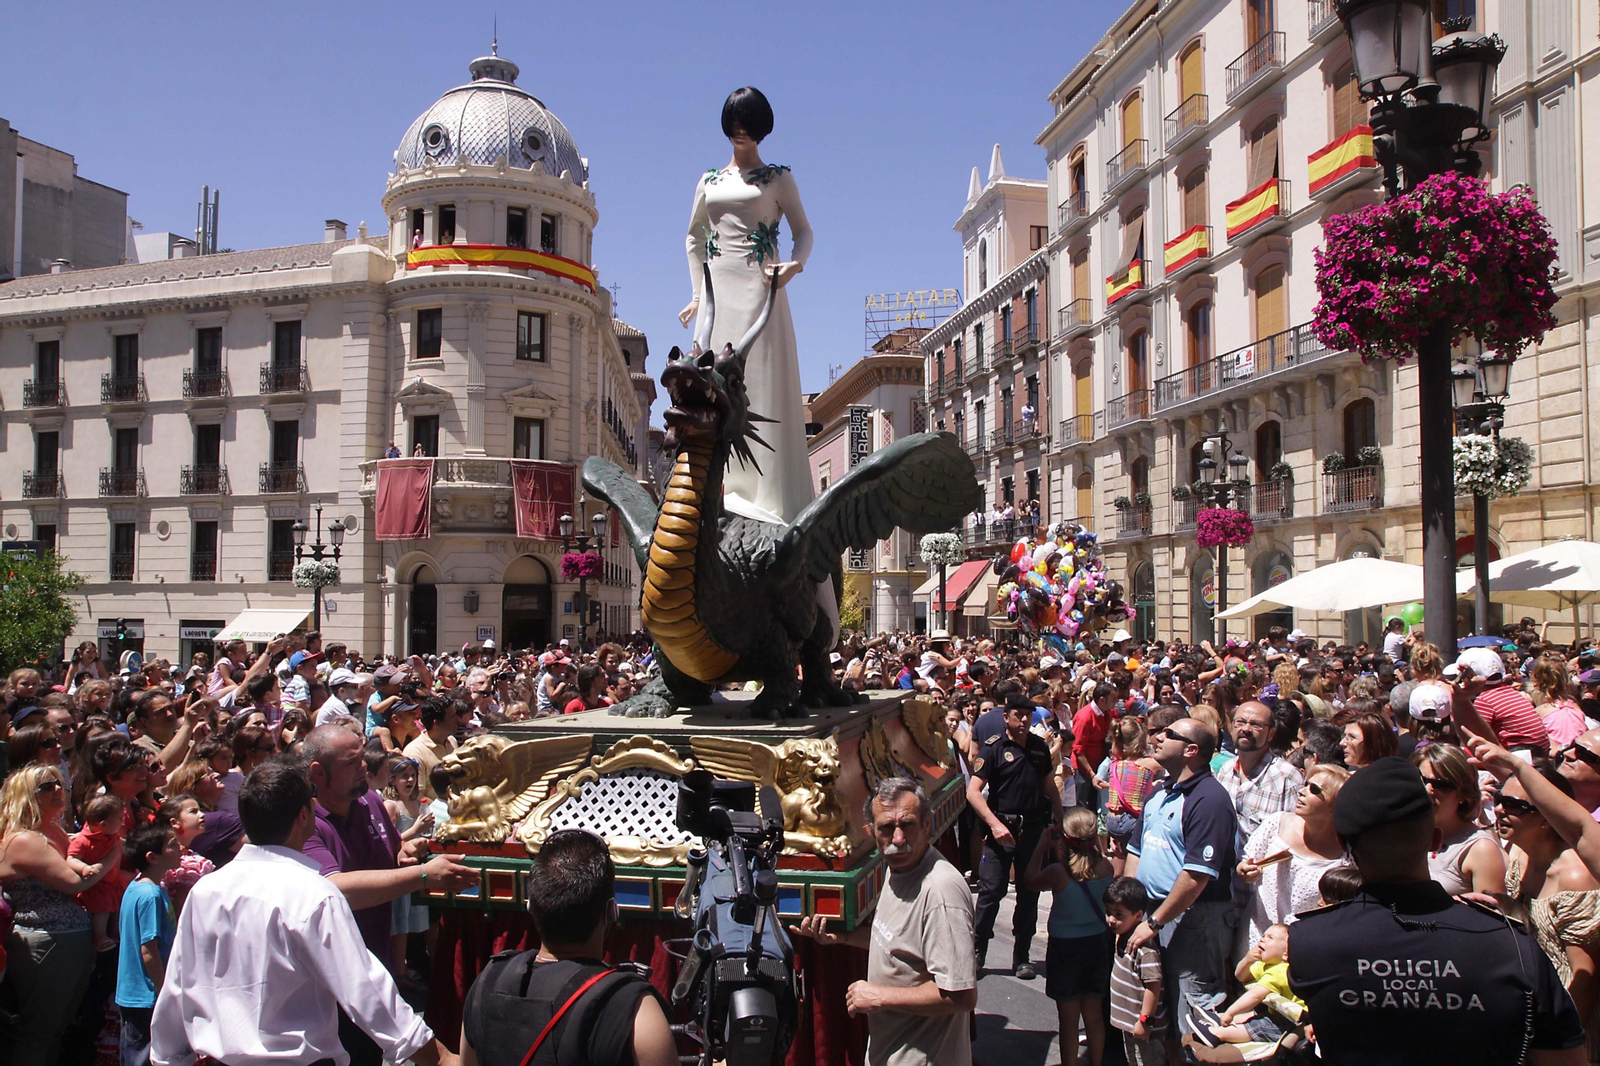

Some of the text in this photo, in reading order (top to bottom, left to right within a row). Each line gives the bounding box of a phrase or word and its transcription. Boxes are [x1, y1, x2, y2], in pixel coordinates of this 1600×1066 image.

[865, 288, 958, 311] ALIATAR
[895, 310, 927, 322] cafe
[1357, 958, 1461, 978] POLICIA
[1382, 979, 1438, 991] LOCAL
[1339, 989, 1486, 1012] GRANADA
